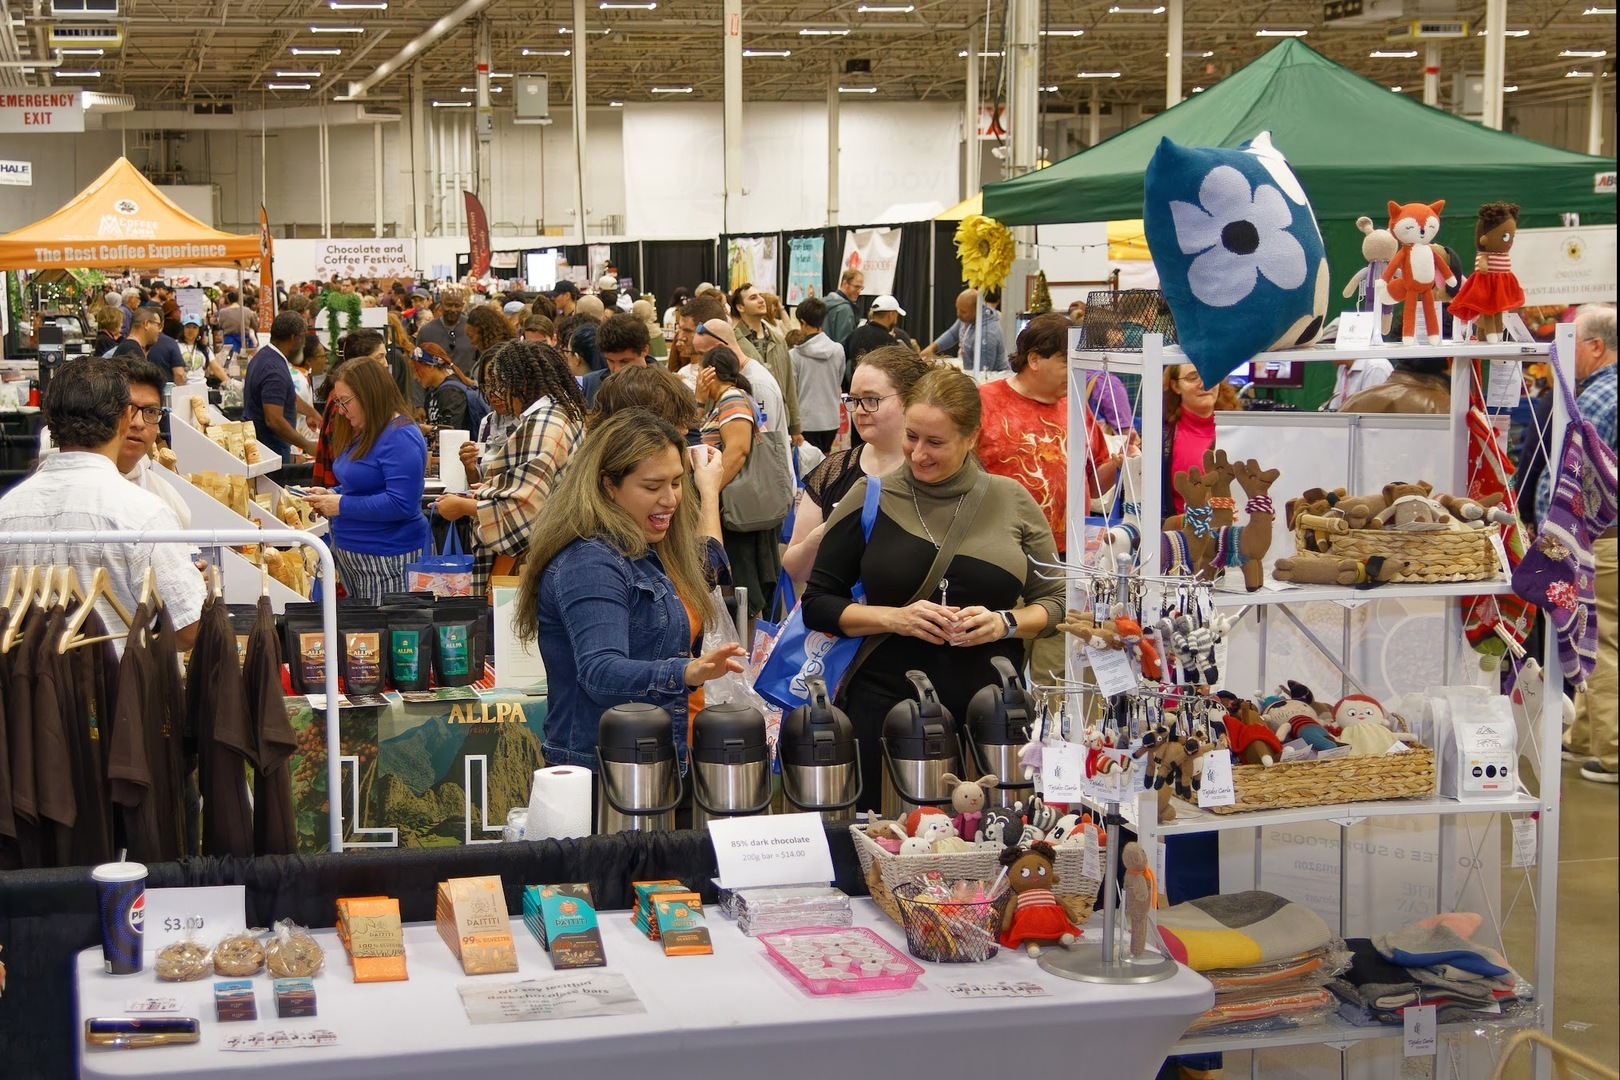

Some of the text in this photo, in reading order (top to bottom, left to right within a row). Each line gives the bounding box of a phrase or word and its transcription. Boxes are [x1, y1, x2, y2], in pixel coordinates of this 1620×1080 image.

[0, 94, 74, 107] EMERGENCY
[24, 112, 52, 125] EXIT
[120, 217, 159, 230] COFFEE
[35, 242, 227, 262] The Best Coffee Experience
[326, 244, 403, 254] Chocolate and
[324, 254, 407, 264] Coffee Festival
[1581, 283, 1616, 293] DESSER
[447, 702, 527, 724] ALLPA
[730, 836, 810, 848] 85% dark chocolate
[742, 853, 761, 862] 200g
[761, 852, 773, 860] bar
[781, 850, 806, 859] $14.00
[164, 917, 204, 932] $3.00
[466, 917, 500, 927] PAITITI
[555, 918, 588, 926] PAITITI
